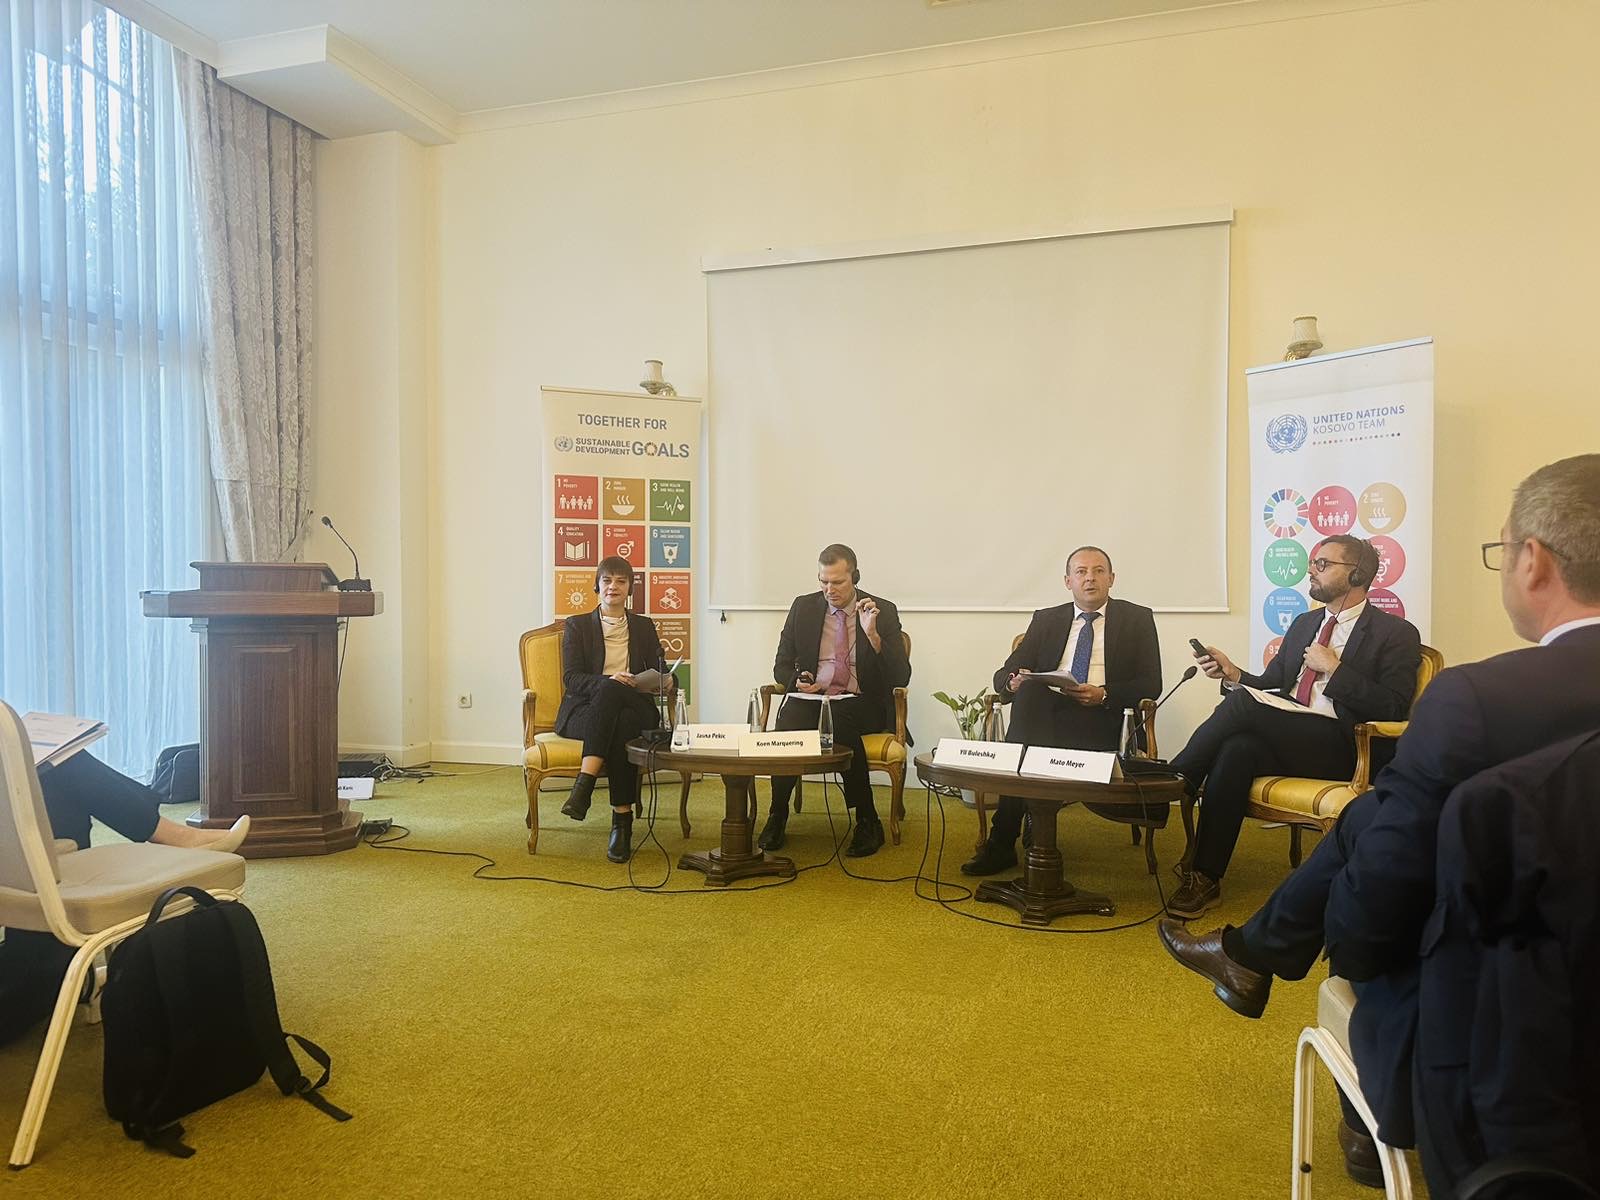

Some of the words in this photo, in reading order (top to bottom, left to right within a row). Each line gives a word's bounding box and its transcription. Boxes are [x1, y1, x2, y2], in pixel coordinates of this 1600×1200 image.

[1313, 411, 1353, 424] UNITED
[1356, 405, 1405, 420] NATIONS
[578, 414, 640, 428] TOGETHER
[644, 418, 667, 430] FOR
[1313, 422, 1355, 434] KOSOVO
[1358, 418, 1385, 430] TEAM
[575, 437, 631, 448] SUSTAINABLE
[575, 446, 630, 456] DEVELOPMENT
[631, 441, 690, 458] GOALS
[556, 478, 561, 488] 1
[604, 480, 611, 490] 2
[652, 482, 658, 492] 3
[1317, 495, 1321, 506] 1
[1362, 493, 1369, 504] 2
[557, 526, 564, 536] 4
[605, 527, 611, 537] 5
[652, 529, 658, 538] 6
[1268, 547, 1273, 558] 3
[558, 574, 563, 584] 7
[652, 575, 658, 585] 9
[1269, 595, 1274, 606] 6
[771, 740, 804, 748] Marquering
[1049, 758, 1066, 767] Mato
[1066, 759, 1085, 769] Meyer
